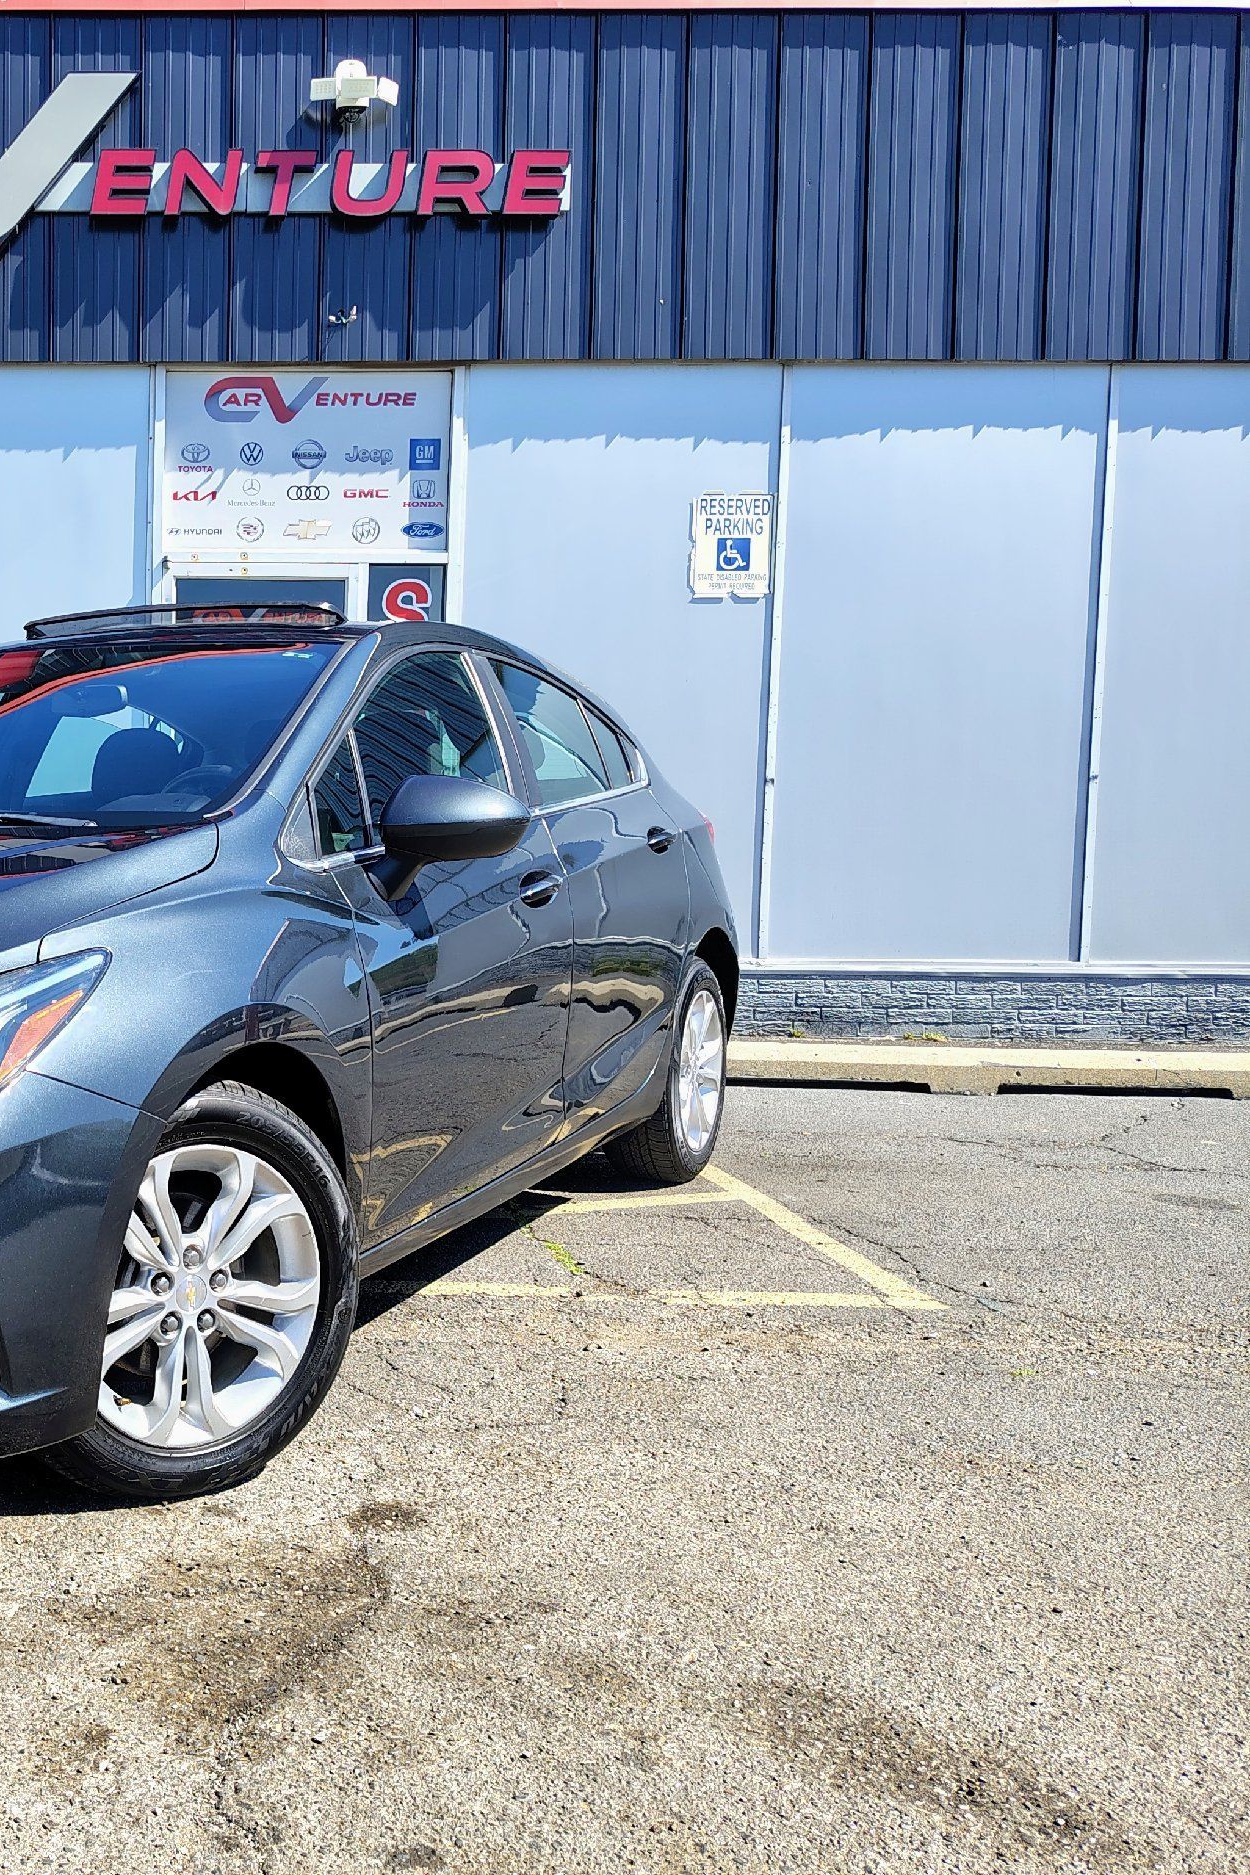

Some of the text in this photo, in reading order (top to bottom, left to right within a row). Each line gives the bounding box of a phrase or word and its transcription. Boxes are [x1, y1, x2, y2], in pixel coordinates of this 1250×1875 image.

[294, 451, 324, 459] NISSAN
[345, 446, 393, 465] Jeep
[415, 445, 434, 459] GM
[173, 491, 217, 501] KIA
[343, 489, 389, 498] GMC
[700, 499, 770, 515] RESERVED
[410, 524, 437, 536] Ford
[705, 518, 763, 535] PARKING
